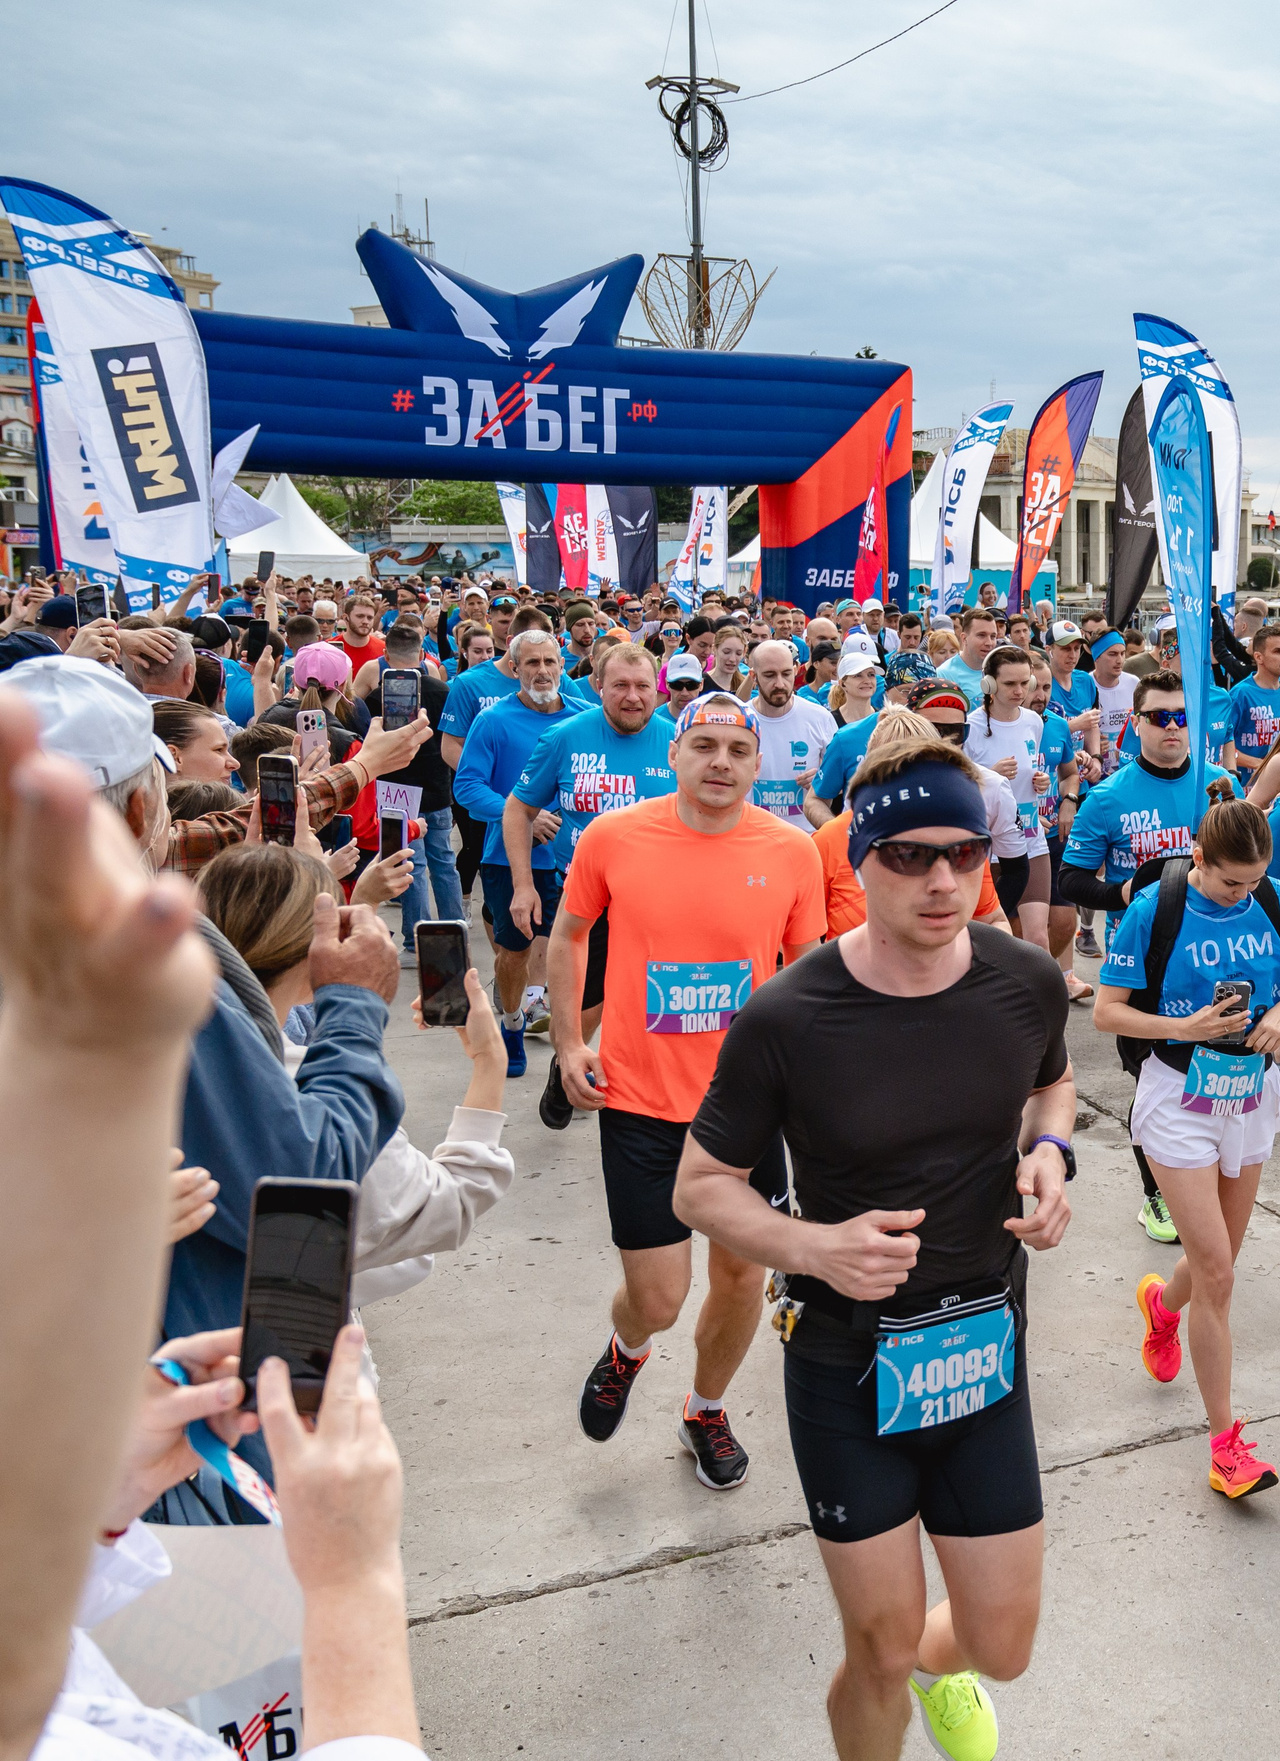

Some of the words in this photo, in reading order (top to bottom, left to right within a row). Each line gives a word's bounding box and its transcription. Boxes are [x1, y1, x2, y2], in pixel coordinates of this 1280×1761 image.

[944, 467, 967, 527] ПСБ
[1027, 471, 1060, 511] ЗА
[1133, 520, 1156, 529] ГЕРОЕ
[805, 567, 899, 590] ЗАБЕФ
[1250, 705, 1274, 720] 2024
[570, 753, 607, 774] 2024
[574, 773, 636, 795] #МЕЧТА
[762, 791, 795, 805] 30279
[1119, 808, 1162, 835] 2024
[1130, 826, 1191, 854] #МЕЧТА
[1108, 952, 1135, 967] ПСБ
[1185, 940, 1221, 968] 10
[669, 984, 731, 1011] 30172
[1206, 1053, 1221, 1062] ПСБ
[1203, 1072, 1256, 1098] 30194
[940, 1294, 961, 1308] gm
[902, 1334, 925, 1346] ПСБ
[906, 1342, 998, 1398] 40093
